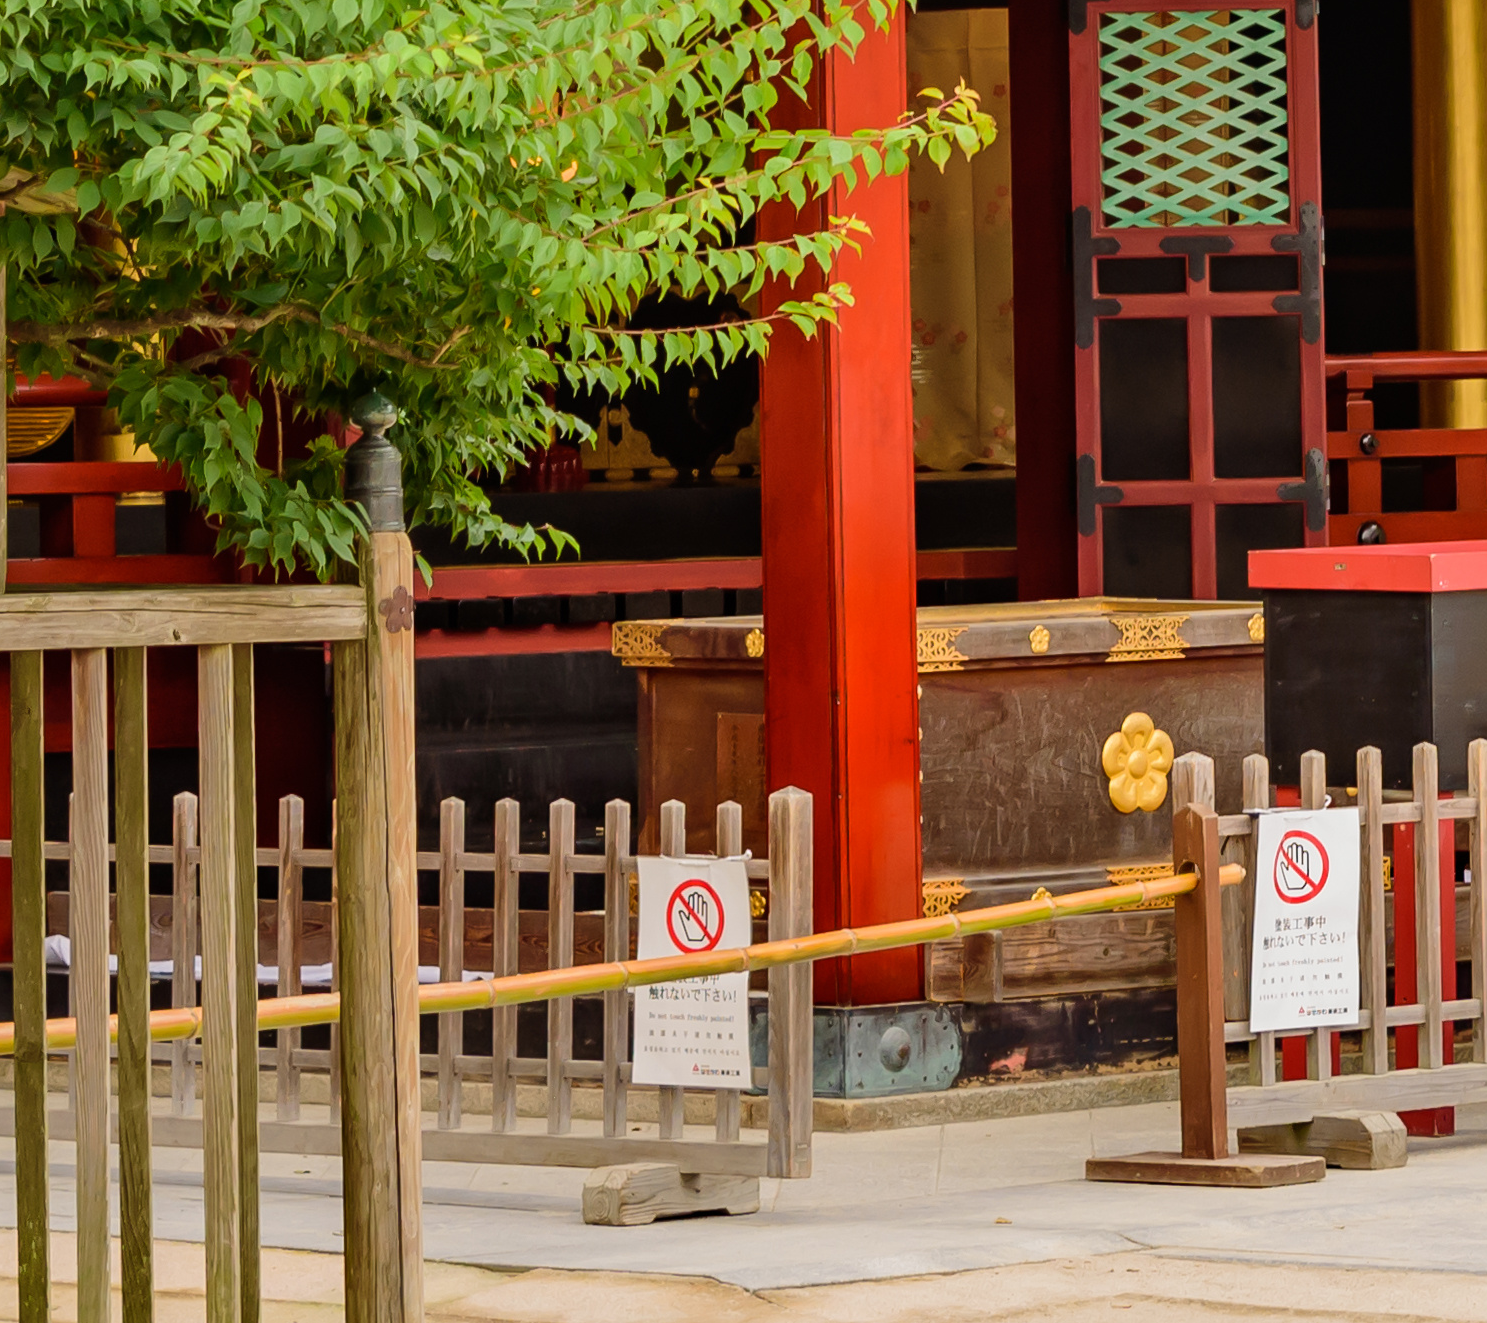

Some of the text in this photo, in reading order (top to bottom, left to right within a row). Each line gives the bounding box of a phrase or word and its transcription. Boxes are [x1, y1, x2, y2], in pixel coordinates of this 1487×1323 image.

[1275, 915, 1326, 932] 塗装工事中
